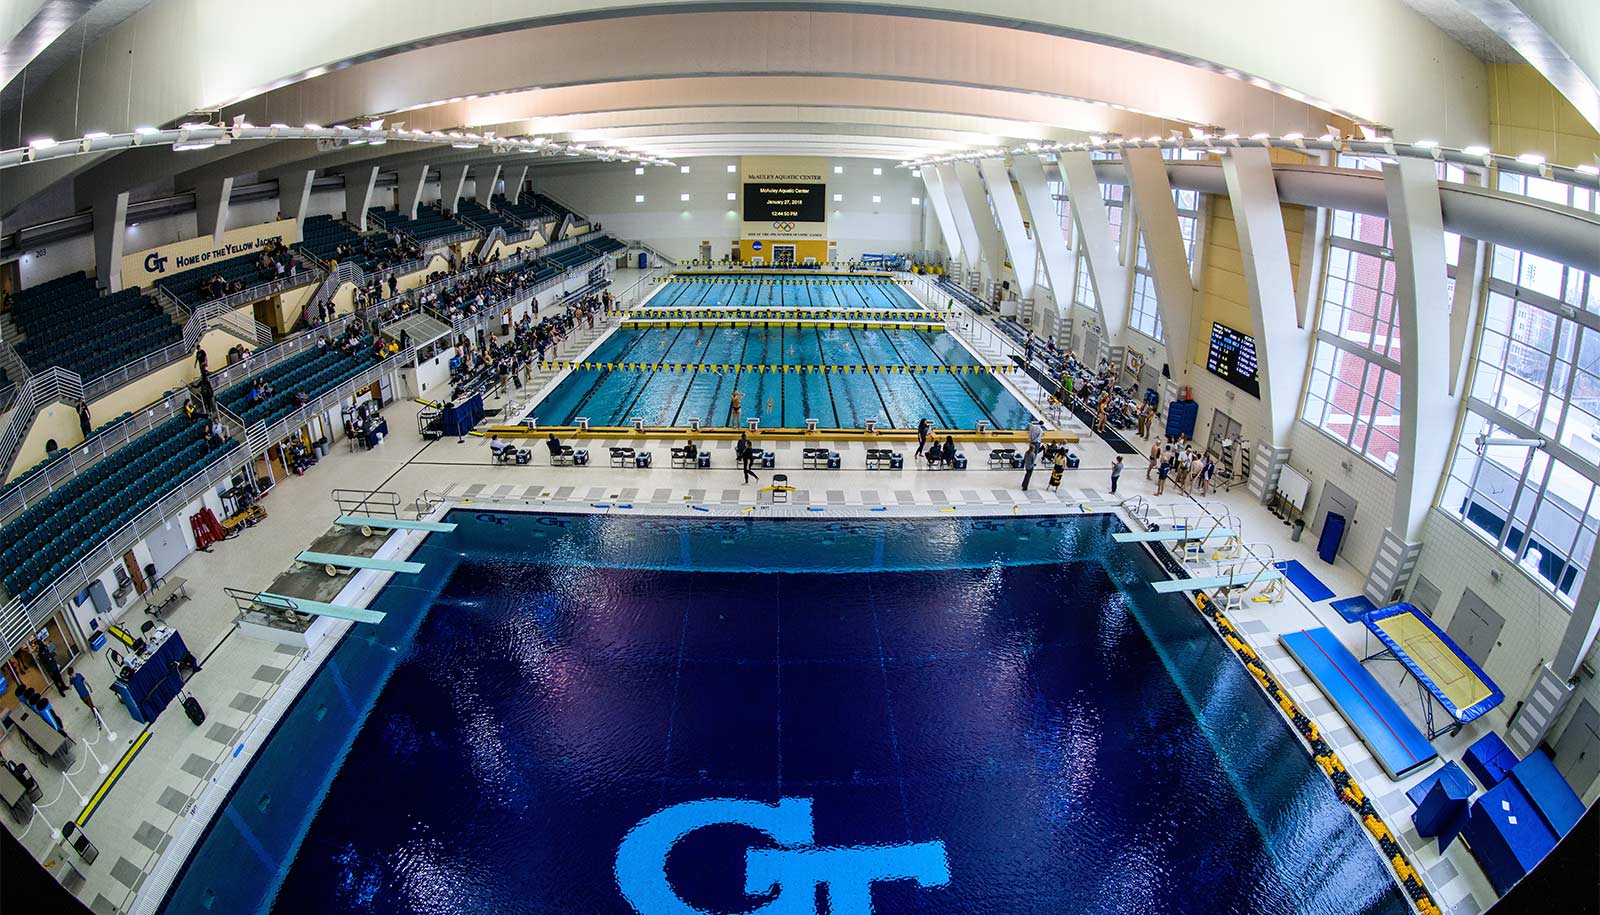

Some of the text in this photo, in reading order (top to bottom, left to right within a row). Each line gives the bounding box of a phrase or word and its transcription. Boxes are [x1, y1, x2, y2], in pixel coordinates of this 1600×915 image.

[36, 248, 47, 258] 203
[144, 252, 168, 273] GT
[614, 796, 950, 915] GT
